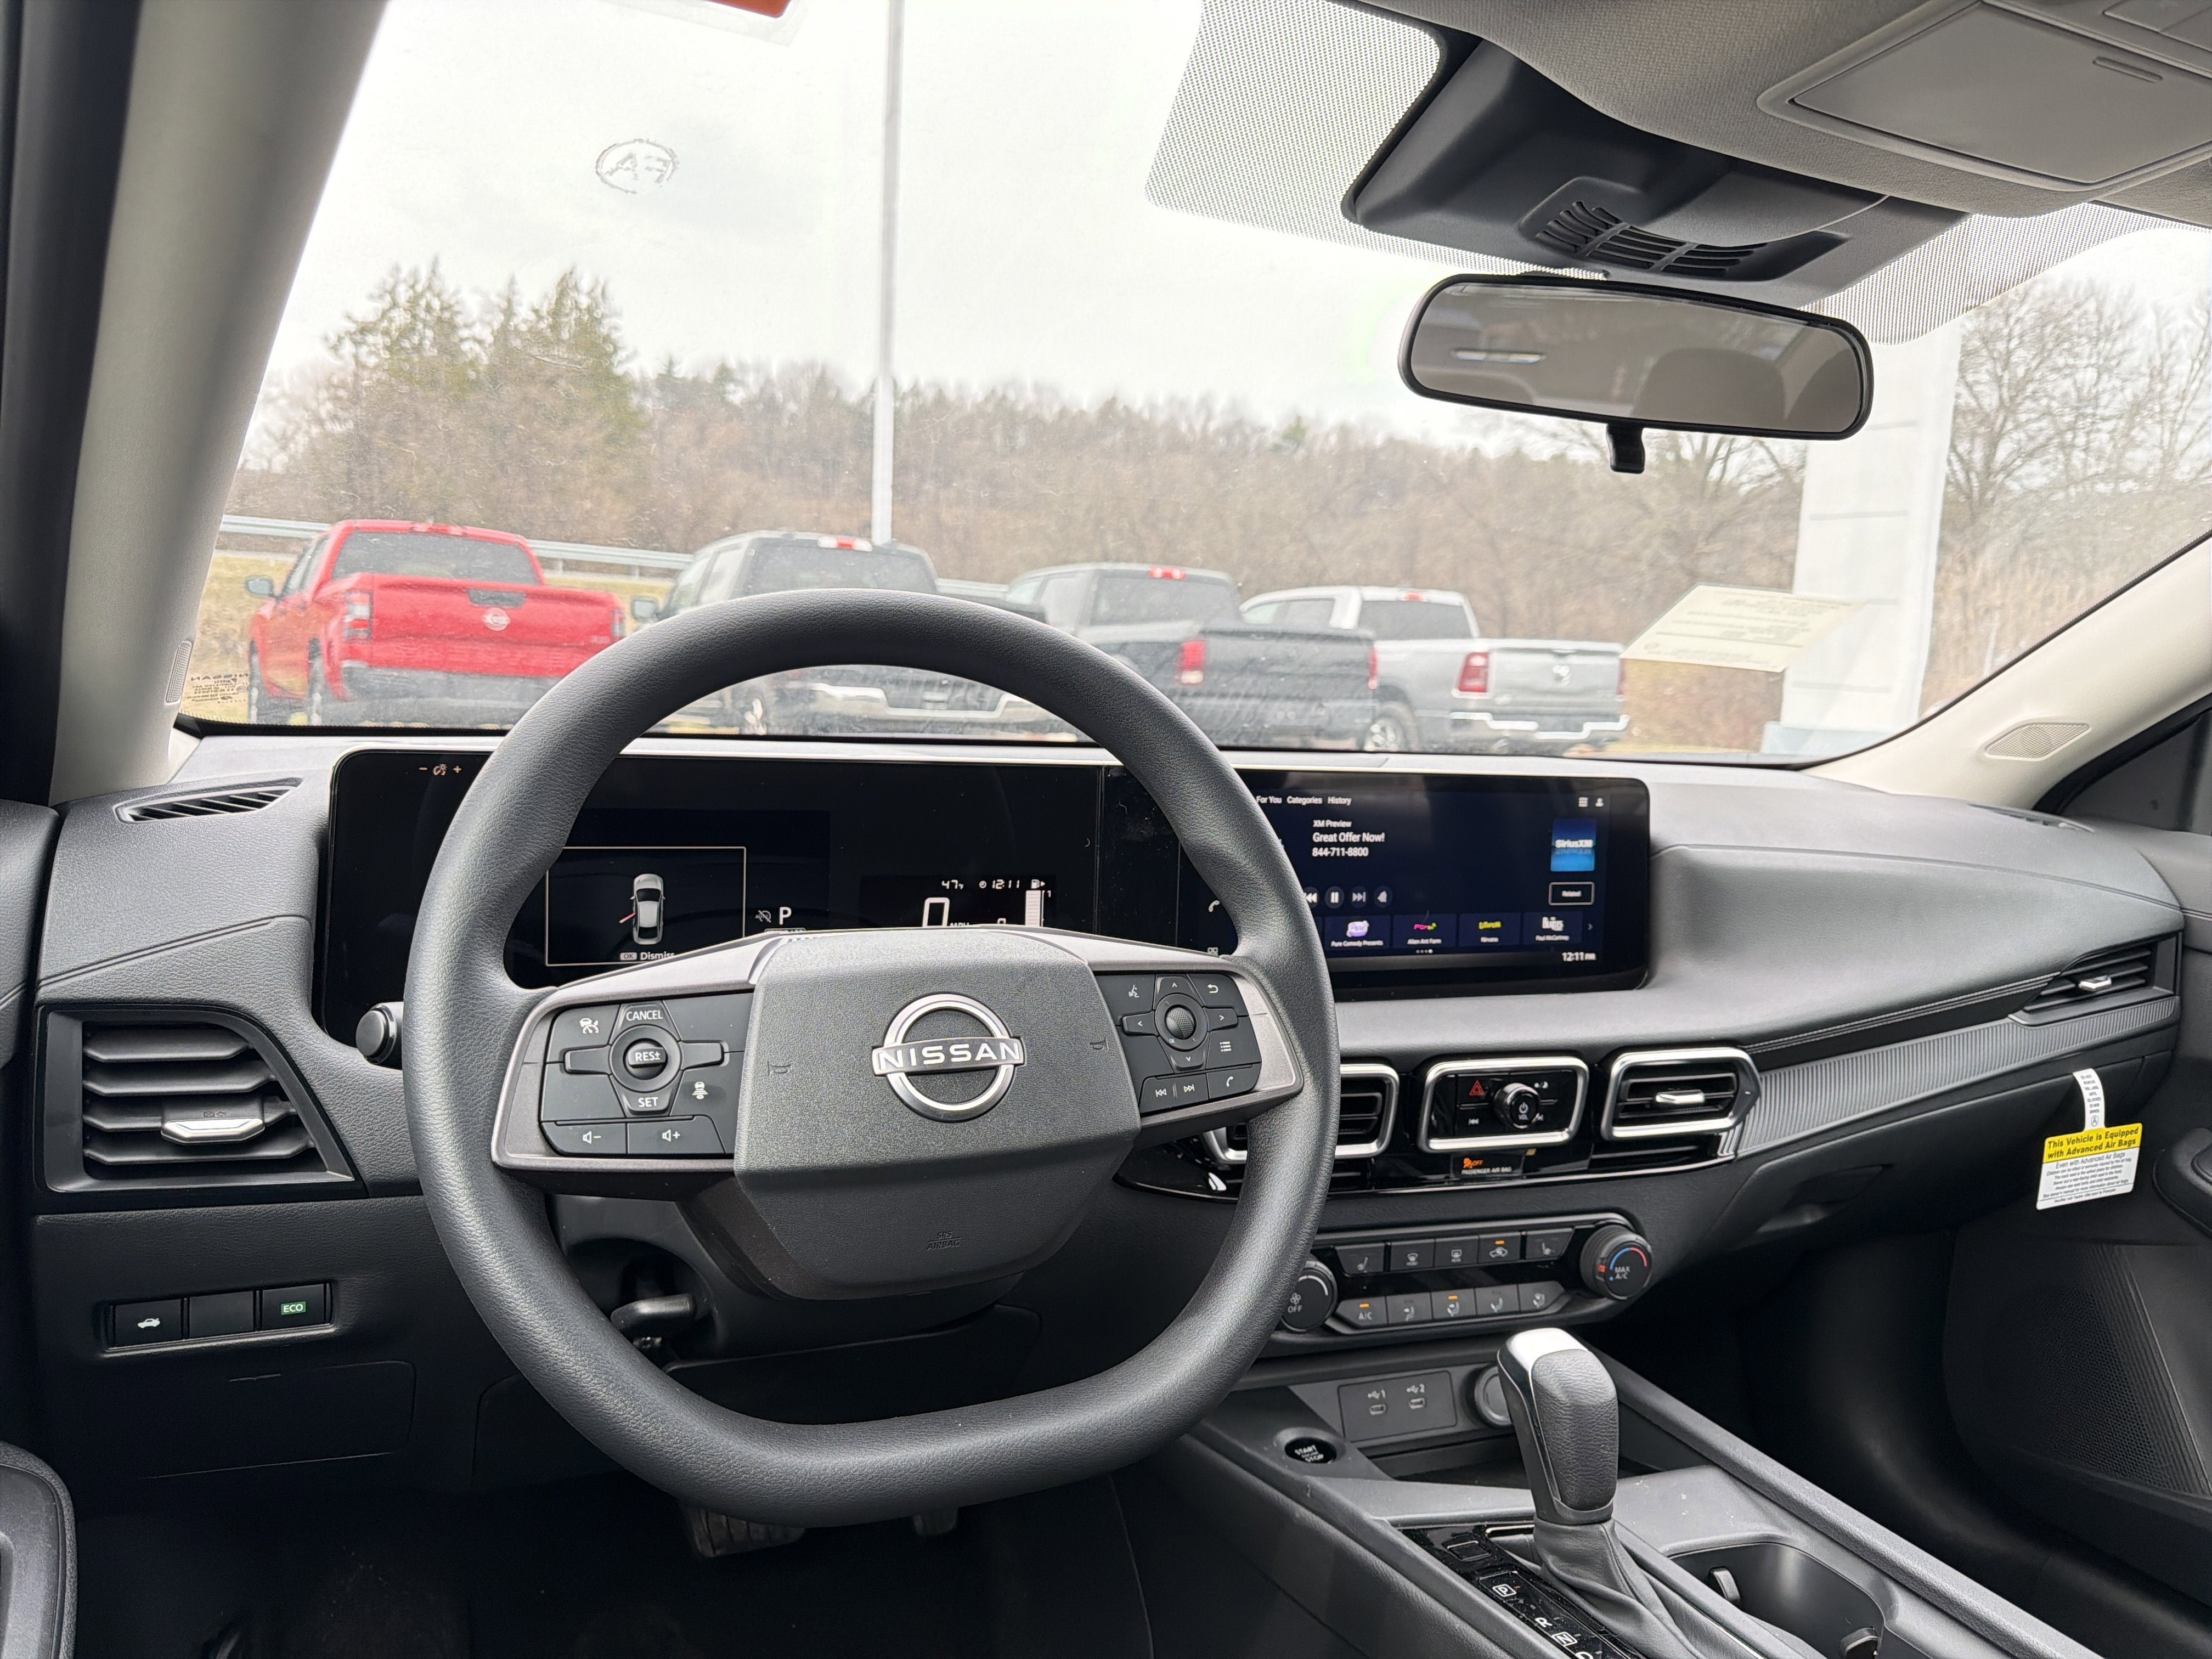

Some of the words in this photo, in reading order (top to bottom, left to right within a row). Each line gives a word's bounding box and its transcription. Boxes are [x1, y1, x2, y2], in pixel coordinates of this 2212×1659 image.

[1286, 796, 1323, 805] Categories
[1328, 797, 1352, 805] History
[1312, 832, 1337, 842] Great
[1339, 832, 1359, 842] Offer
[1362, 832, 1385, 842] Now!
[1555, 839, 1594, 848] SiriusXM
[1312, 847, 1369, 857] 844-711-8800
[992, 879, 1020, 890] 12:11
[779, 906, 792, 926] P
[1562, 952, 1584, 961] 12:11
[1584, 952, 1596, 961] PM
[626, 1009, 664, 1022] CANCEL
[878, 1042, 1020, 1070] NISSAN
[637, 1097, 659, 1108] SET
[2047, 1139, 2064, 1150] This
[2066, 1134, 2094, 1146] Vehicle
[2096, 1132, 2102, 1141] is
[2105, 1127, 2139, 1139] Equipped
[2047, 1149, 2064, 1159] with
[2066, 1142, 2103, 1156] Advanced
[2104, 1141, 2116, 1150] Air
[2118, 1138, 2136, 1147] Bags
[283, 1304, 303, 1313] ECO
[1287, 1305, 1302, 1313] OFF
[1358, 1311, 1373, 1321] A/C
[1534, 1617, 1553, 1628] R
[1556, 1633, 1574, 1644] N
